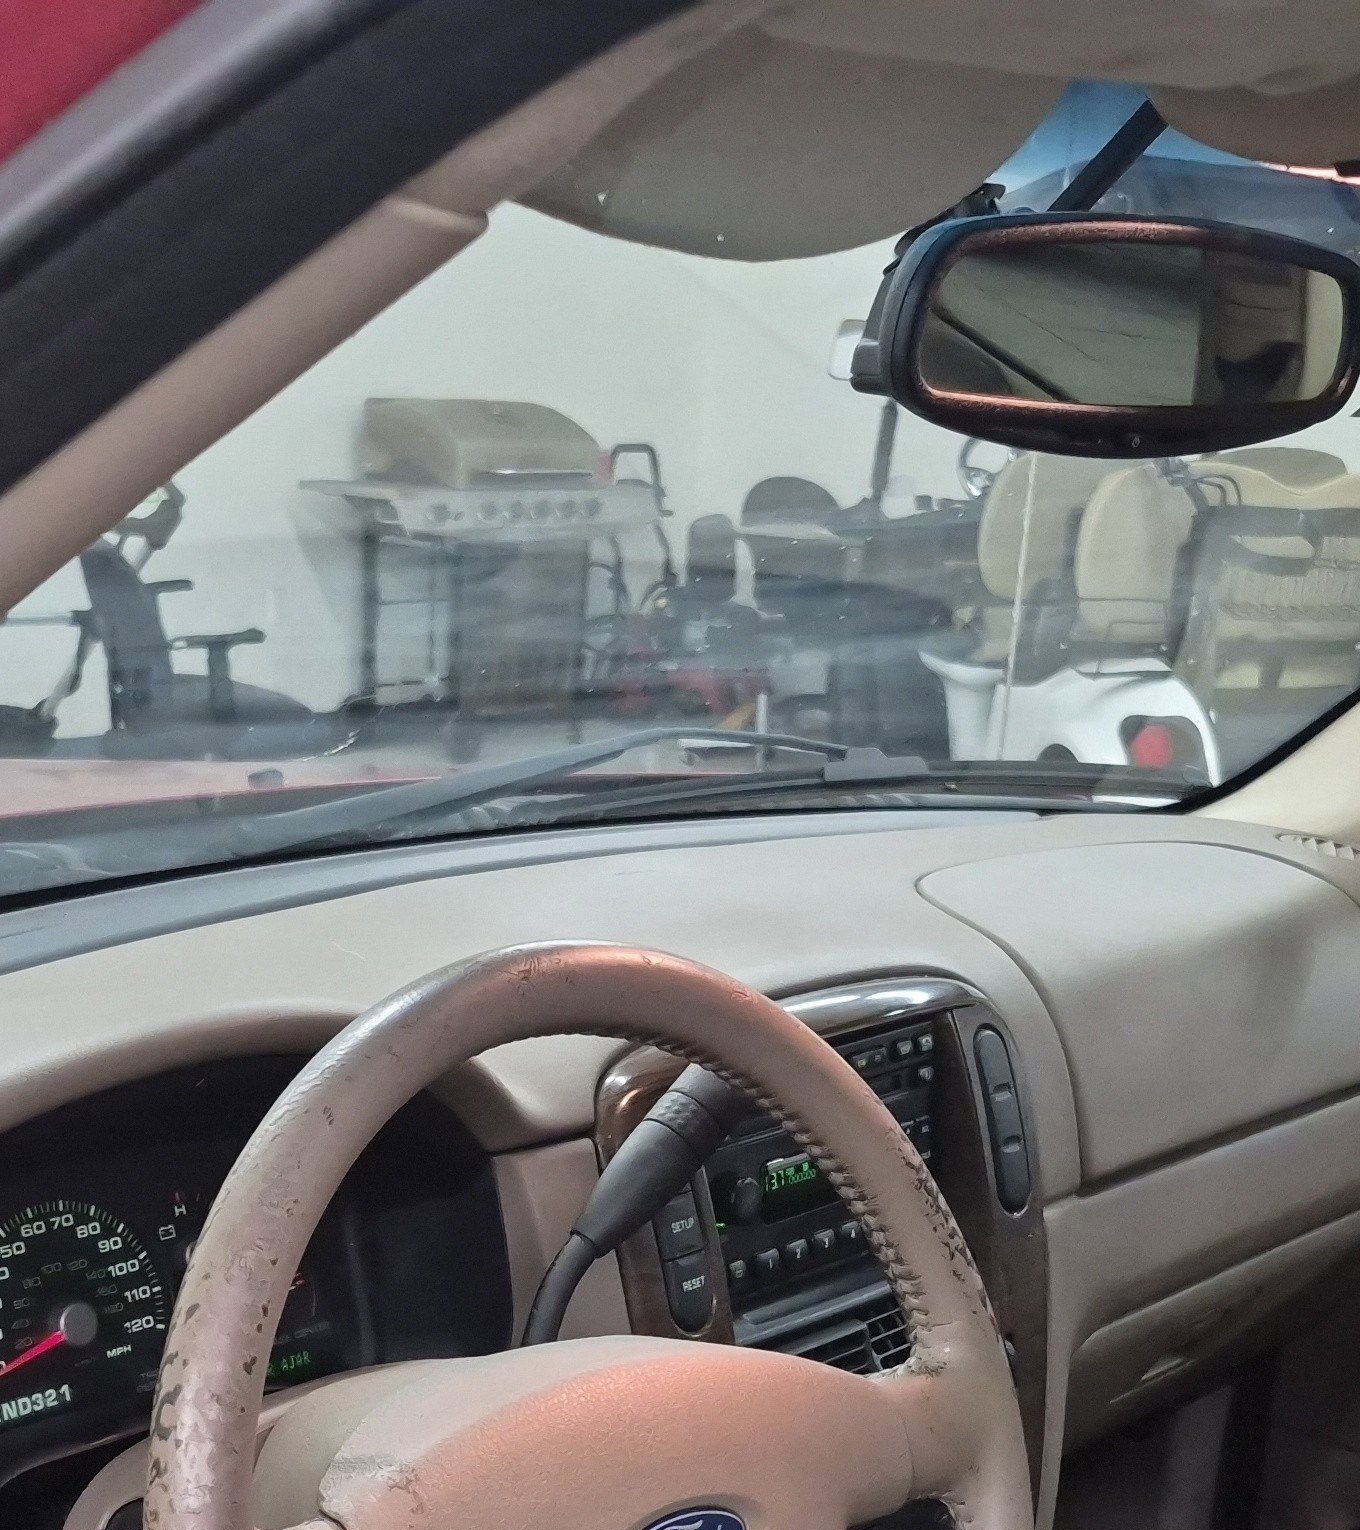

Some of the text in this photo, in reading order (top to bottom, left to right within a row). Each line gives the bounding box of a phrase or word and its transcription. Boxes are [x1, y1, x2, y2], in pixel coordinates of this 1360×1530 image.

[174, 1204, 187, 1217] H
[20, 1221, 46, 1237] 60
[50, 1213, 74, 1230] 70
[76, 1222, 101, 1238] 80
[671, 1217, 695, 1233] SETUP
[0, 1241, 26, 1258] 50
[98, 1236, 122, 1253] 90
[108, 1259, 139, 1277] 100
[683, 1275, 705, 1292] RESET
[124, 1285, 151, 1302] 110
[124, 1315, 154, 1333] 120
[106, 1344, 132, 1358] MPH
[281, 1351, 311, 1371] AJAR
